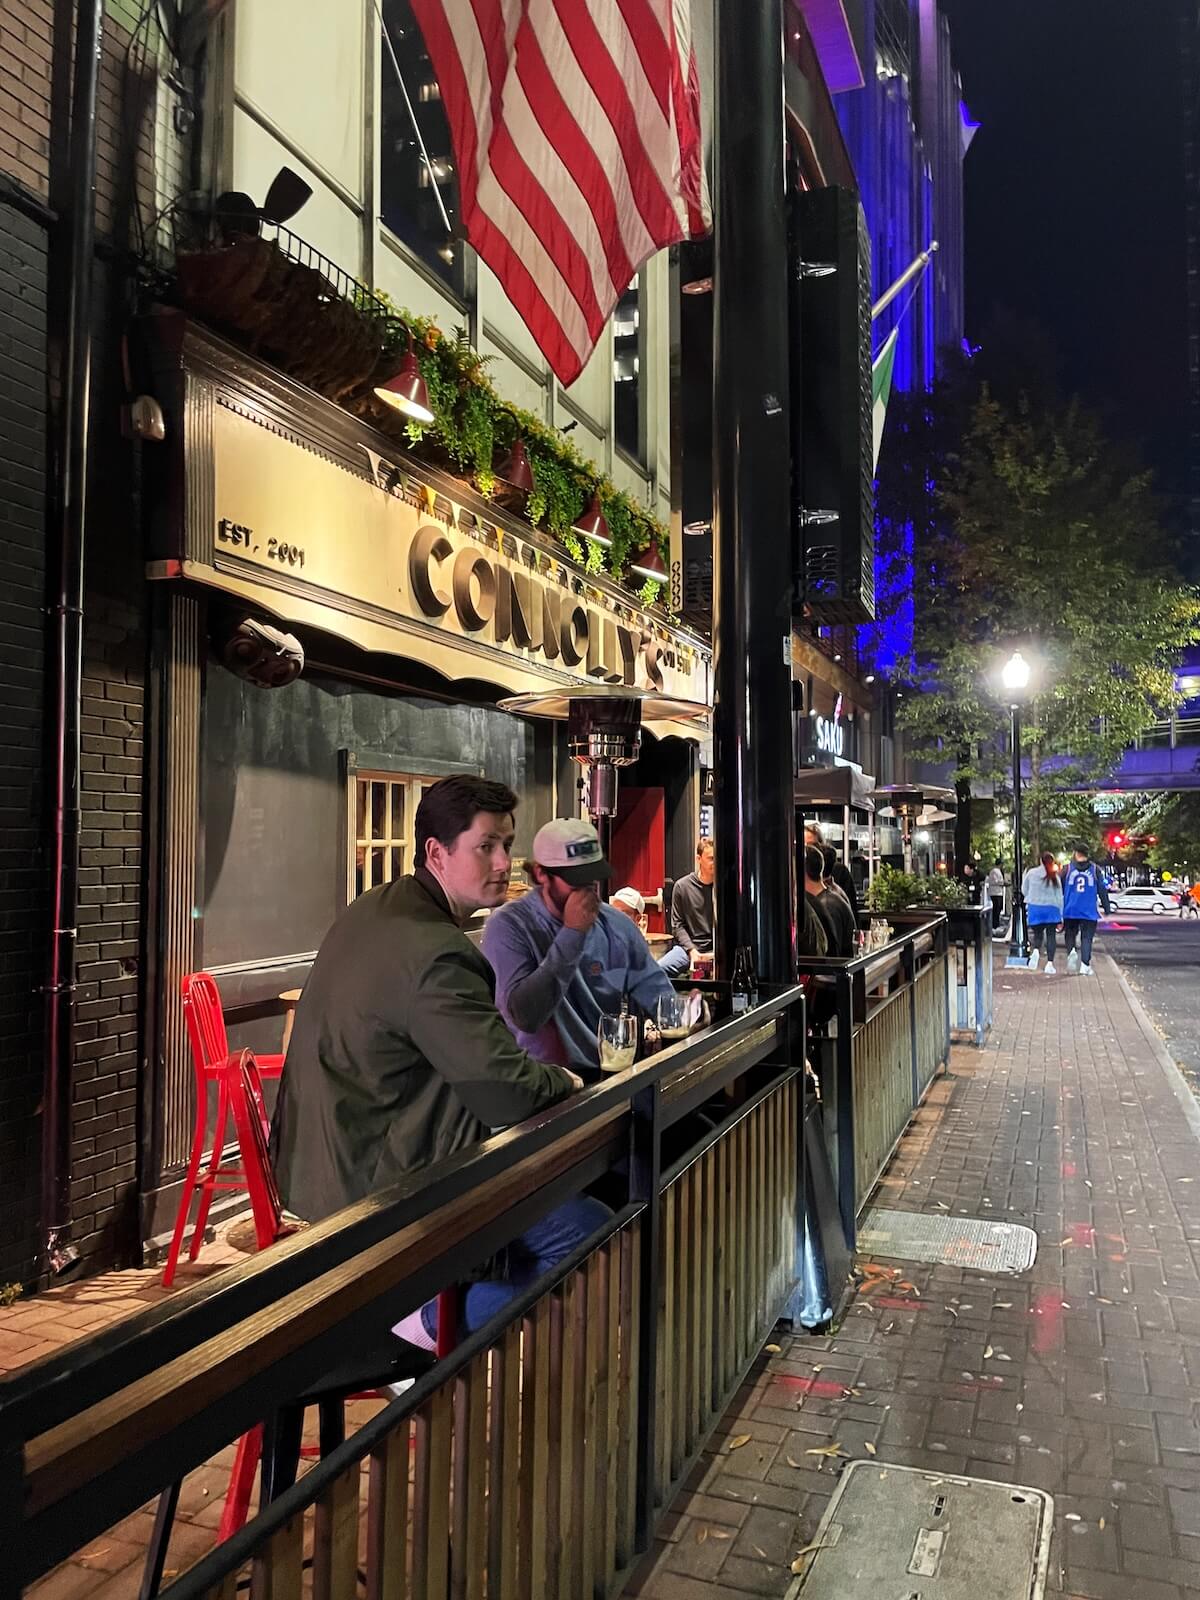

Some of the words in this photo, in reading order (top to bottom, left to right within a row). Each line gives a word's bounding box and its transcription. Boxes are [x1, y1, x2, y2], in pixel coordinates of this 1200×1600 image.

[268, 537, 305, 568] 2001
[816, 715, 843, 756] SAKU
[1076, 876, 1086, 893] 2
